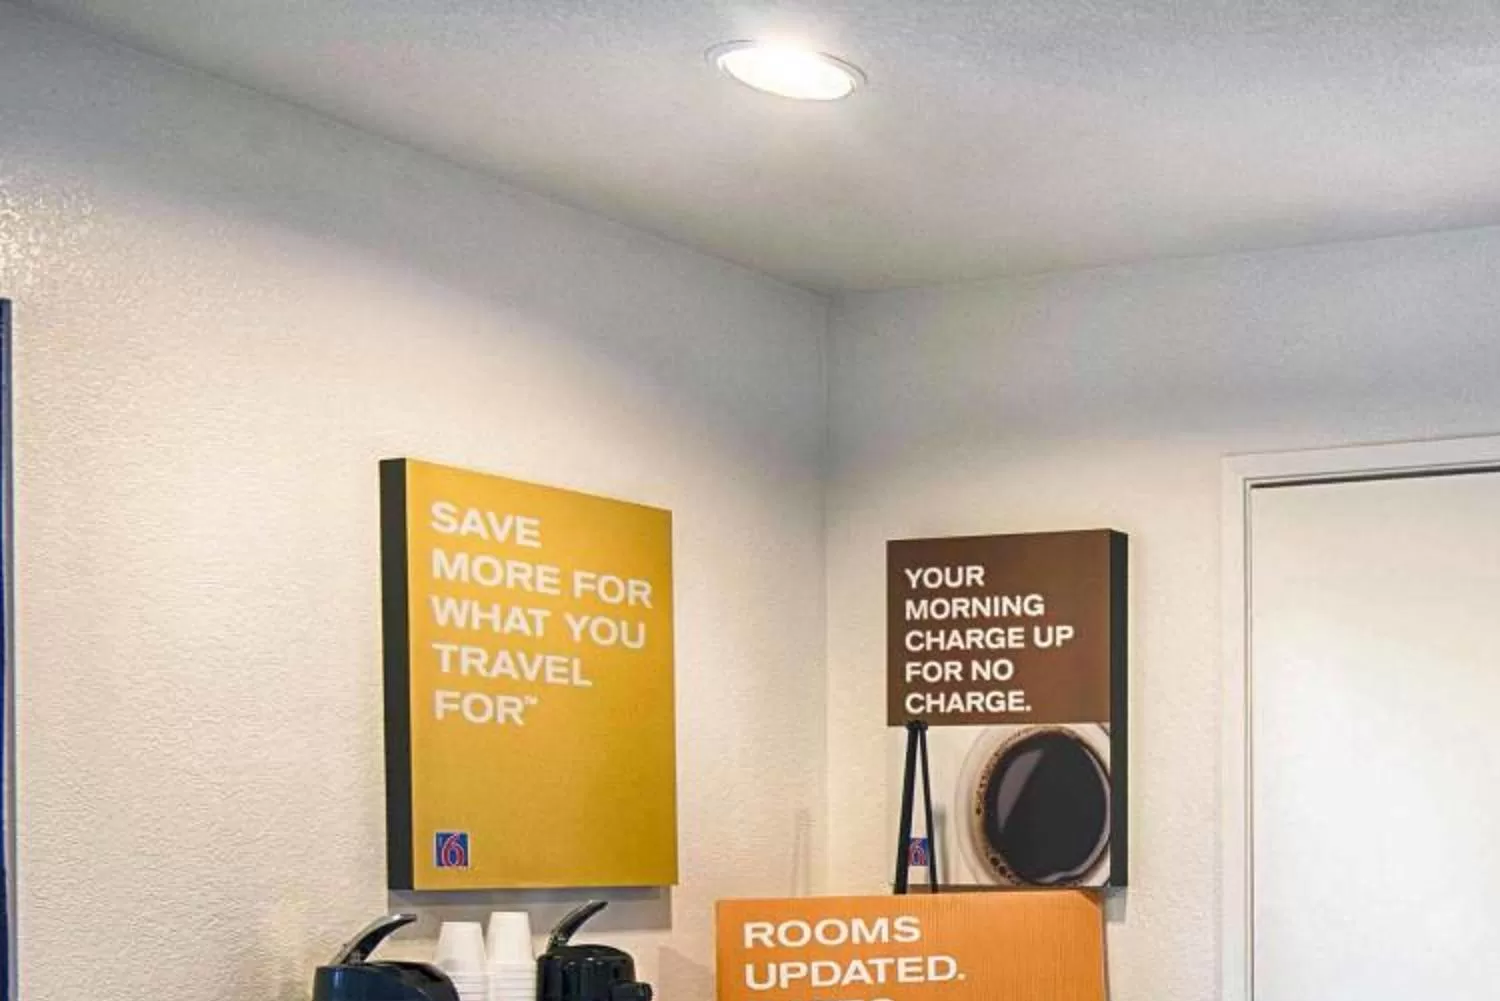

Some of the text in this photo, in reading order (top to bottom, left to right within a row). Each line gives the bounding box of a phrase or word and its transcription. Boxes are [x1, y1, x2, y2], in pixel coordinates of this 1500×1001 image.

[431, 501, 542, 549] SAVE
[432, 548, 653, 609] MORE FOR
[905, 565, 985, 589] YOUR
[431, 595, 646, 650] WHAT YOU
[905, 594, 1045, 620] MORNING
[905, 625, 1074, 651] CHARGE UP
[432, 643, 592, 687] TRAVEL
[905, 659, 1014, 683] FOR NO
[905, 690, 1031, 713] CHARGE.
[744, 916, 921, 949] ROOMS
[745, 955, 966, 990] UPDATED.
